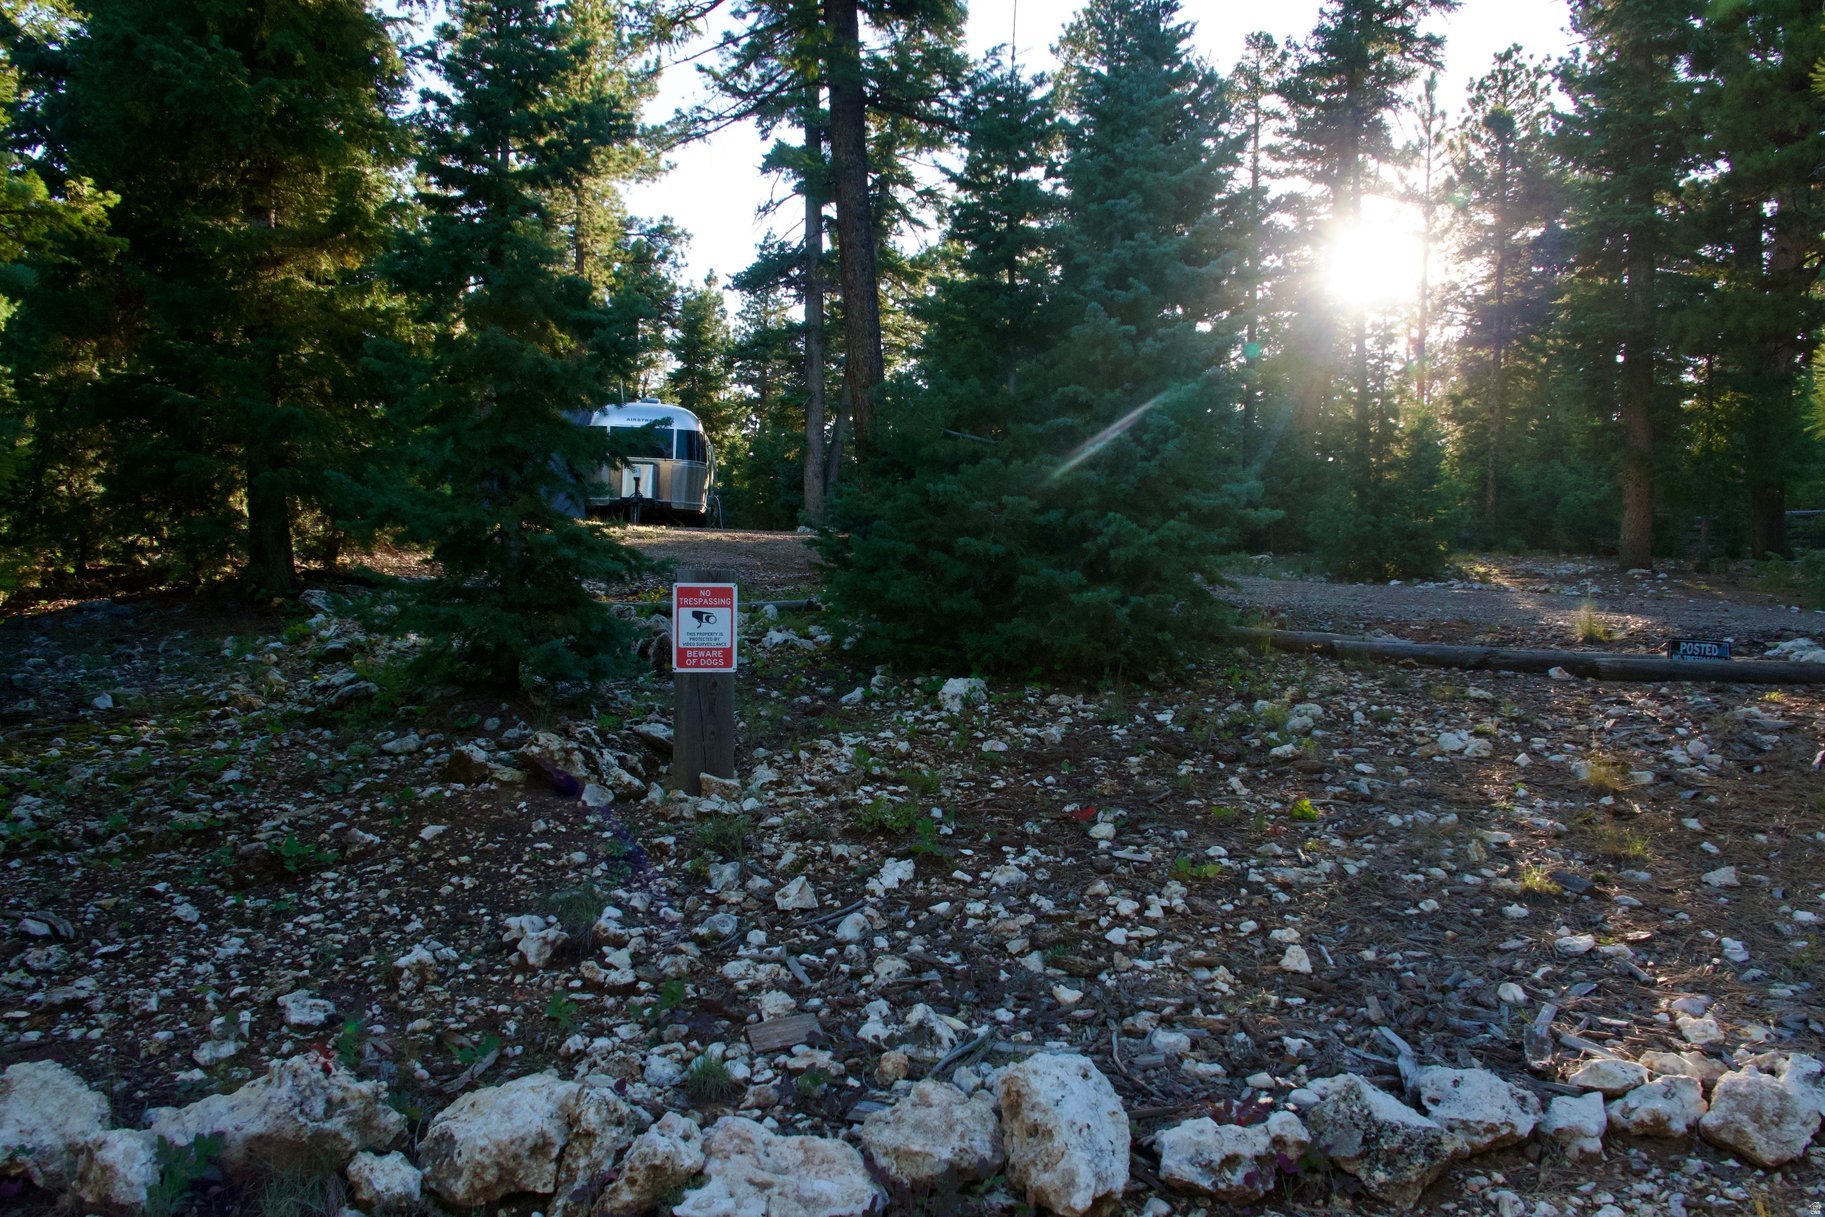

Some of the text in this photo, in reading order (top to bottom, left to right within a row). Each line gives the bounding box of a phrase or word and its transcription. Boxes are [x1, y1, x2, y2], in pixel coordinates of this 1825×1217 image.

[700, 589, 711, 597] NO
[679, 597, 731, 605] TRESPASSING
[1680, 641, 1718, 656] POSTED
[686, 650, 724, 658] BEWARE
[685, 658, 724, 666] OF DOGS
